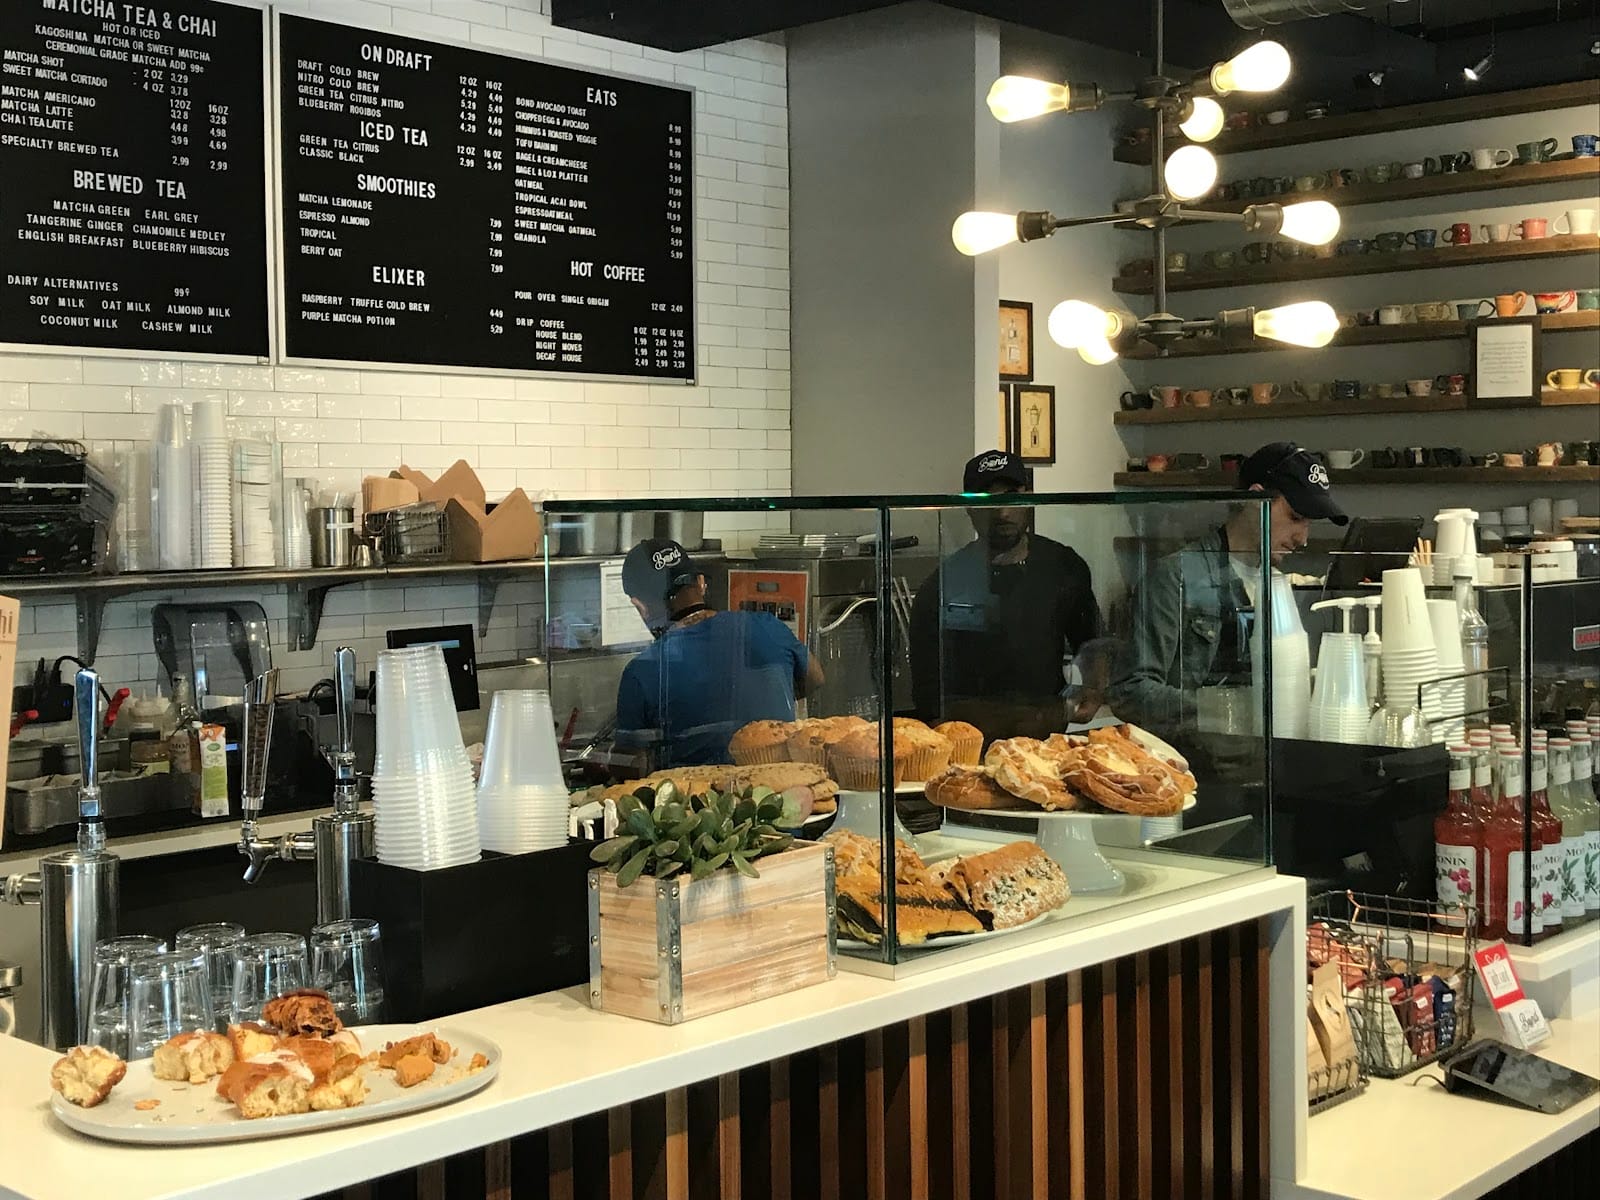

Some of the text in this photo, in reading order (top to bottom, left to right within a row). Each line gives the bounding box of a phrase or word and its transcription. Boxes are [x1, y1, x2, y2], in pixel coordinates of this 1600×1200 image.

[43, 0, 216, 37] MATCHA TEA & CHAI
[102, 22, 160, 40] HOT OR ICED
[35, 24, 210, 62] KAGOSHIMA MATCHA OR SWEET MATCHA
[4, 50, 39, 64] MATCHA
[41, 55, 64, 68] SHOT
[46, 40, 98, 57] CEREMONIAL
[100, 48, 128, 62] GRADE
[132, 54, 167, 68] MATCHA
[169, 59, 186, 70] ADD
[361, 44, 432, 71] ON DRAFT
[2, 63, 164, 93] SWEET MATCHA CORTADO 4 OZ
[298, 59, 380, 82] DRAFT COLD BREW
[298, 72, 380, 94] NITRO COLD BREW
[1, 85, 96, 107] MATCHA AMERICANO
[298, 84, 404, 110] GREEN TEA CITRUS NITRO
[586, 87, 617, 106] EATS
[1, 99, 73, 118] MATCHA LATTE
[298, 97, 382, 118] BLUEBERRY ROOIBOS
[516, 97, 586, 117] BOND AVOCADO TOAST
[0, 112, 26, 125] CHAI
[562, 118, 590, 130] AVOCADO
[360, 121, 428, 147] ICED TEA
[516, 138, 533, 148] TOFU
[548, 129, 574, 141] ROASTED
[575, 134, 597, 145] VEGGIE
[1, 134, 119, 158] SPECIALTY BREWED TEA
[300, 134, 380, 154] GREEN TEA CITRUS
[299, 146, 364, 164] CLASSIC BLACK
[516, 152, 536, 162] BAGEL
[516, 165, 536, 176] BAGEL
[543, 169, 557, 178] LOX
[558, 171, 588, 183] PLATTER
[74, 170, 186, 200] BREWED TEA
[357, 174, 436, 199] SMOOTHIES
[514, 178, 544, 190] OATMEAL
[298, 193, 373, 210] MATCHA LEMONADE
[515, 192, 588, 210] TROPICAL ACAI BOWL
[53, 200, 198, 224] MATCHA GREEN EARL GREY
[299, 210, 370, 226] ESPRESSO ALMOND
[26, 214, 226, 241] TANGERINE GINGER CHAMOMILE MEDLEY
[300, 227, 337, 240] TROPICAL
[514, 219, 596, 236] SWEET MATCHA OATMEAL
[18, 229, 230, 257] ENGLISH BREAKFAST BLUEBERRY HIBISCUS
[514, 232, 546, 244] GRANOLA
[301, 244, 342, 258] BERRY OAT
[373, 266, 425, 286] ELIXER
[571, 260, 645, 282] HOT COFFEE
[8, 274, 118, 292] DAIRY ALTERNATIVES
[30, 295, 230, 318] SOY MILK OAT MILK ALMOND MILK
[302, 294, 430, 312] RASPBERRY TRUFFLE COLD BREW
[514, 290, 609, 306] POUR OVER SINGLE ORIGIN
[40, 314, 212, 334] COCONUT MILK CASHEW MILK
[302, 310, 396, 326] PURPLE MATCHA POTION
[516, 317, 565, 329] DRIP COFFEE
[536, 330, 583, 341] HOUSE BLEND
[536, 341, 582, 352] NIGHT MOVES
[536, 352, 582, 362] DECAF HOUSE
[1436, 856, 1466, 866] ONIN
